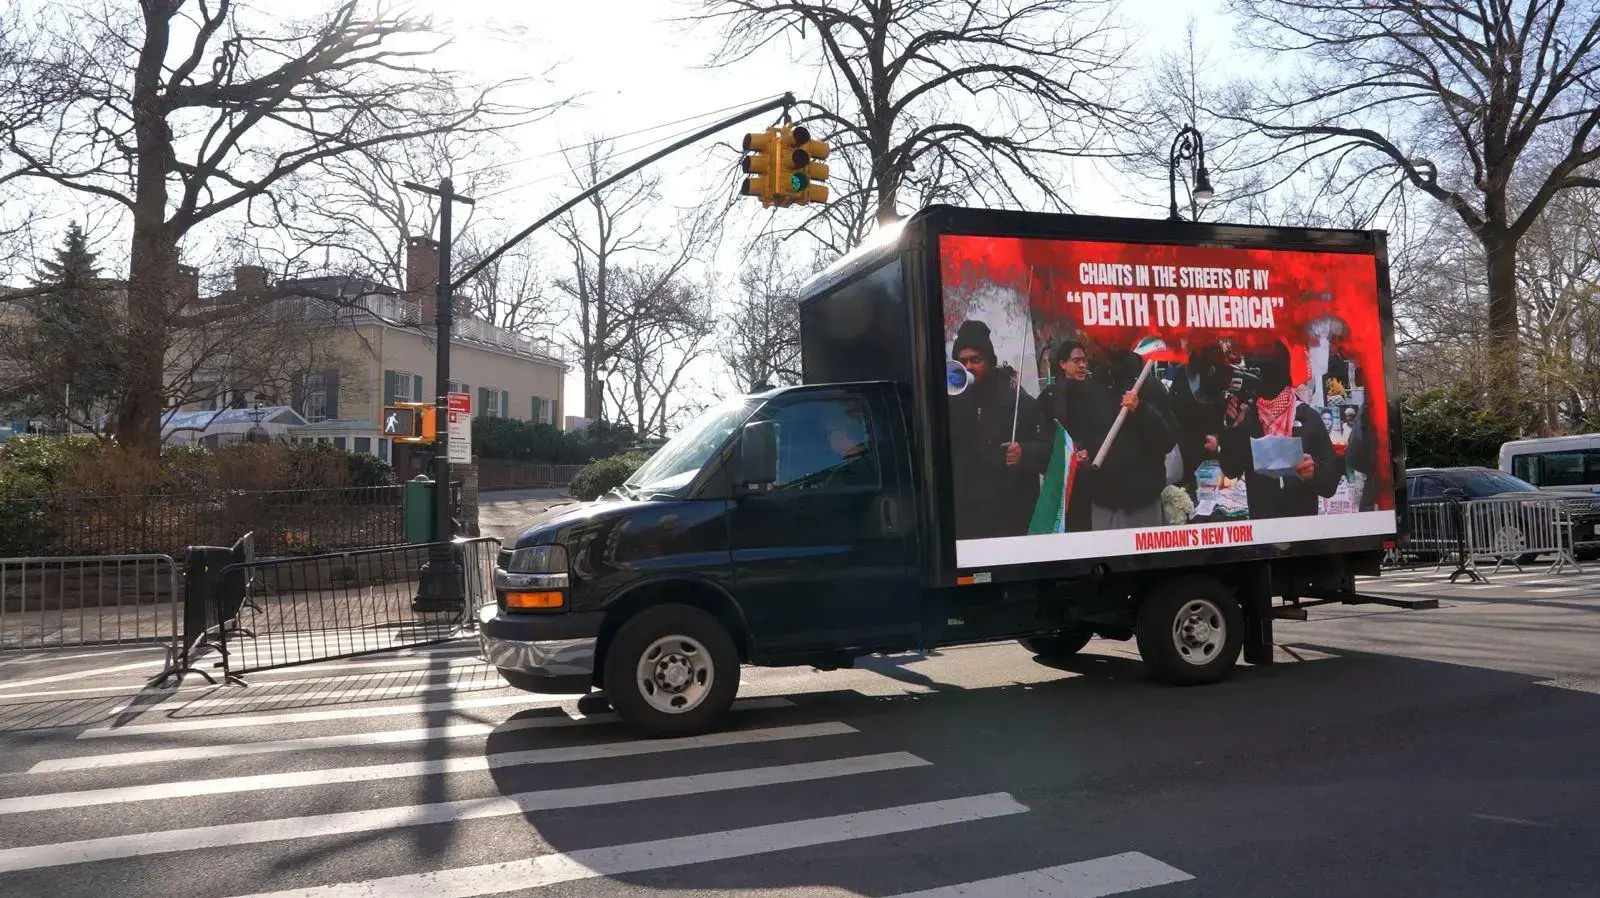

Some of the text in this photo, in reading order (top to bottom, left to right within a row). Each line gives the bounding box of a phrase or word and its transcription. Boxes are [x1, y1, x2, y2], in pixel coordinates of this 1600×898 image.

[1079, 262, 1269, 291] CHANTS IN THE STREETS OF NY
[1066, 291, 1284, 329] “DEATH TO AMERICA”
[1135, 525, 1254, 551] MAMDANI'S NEW YORK
